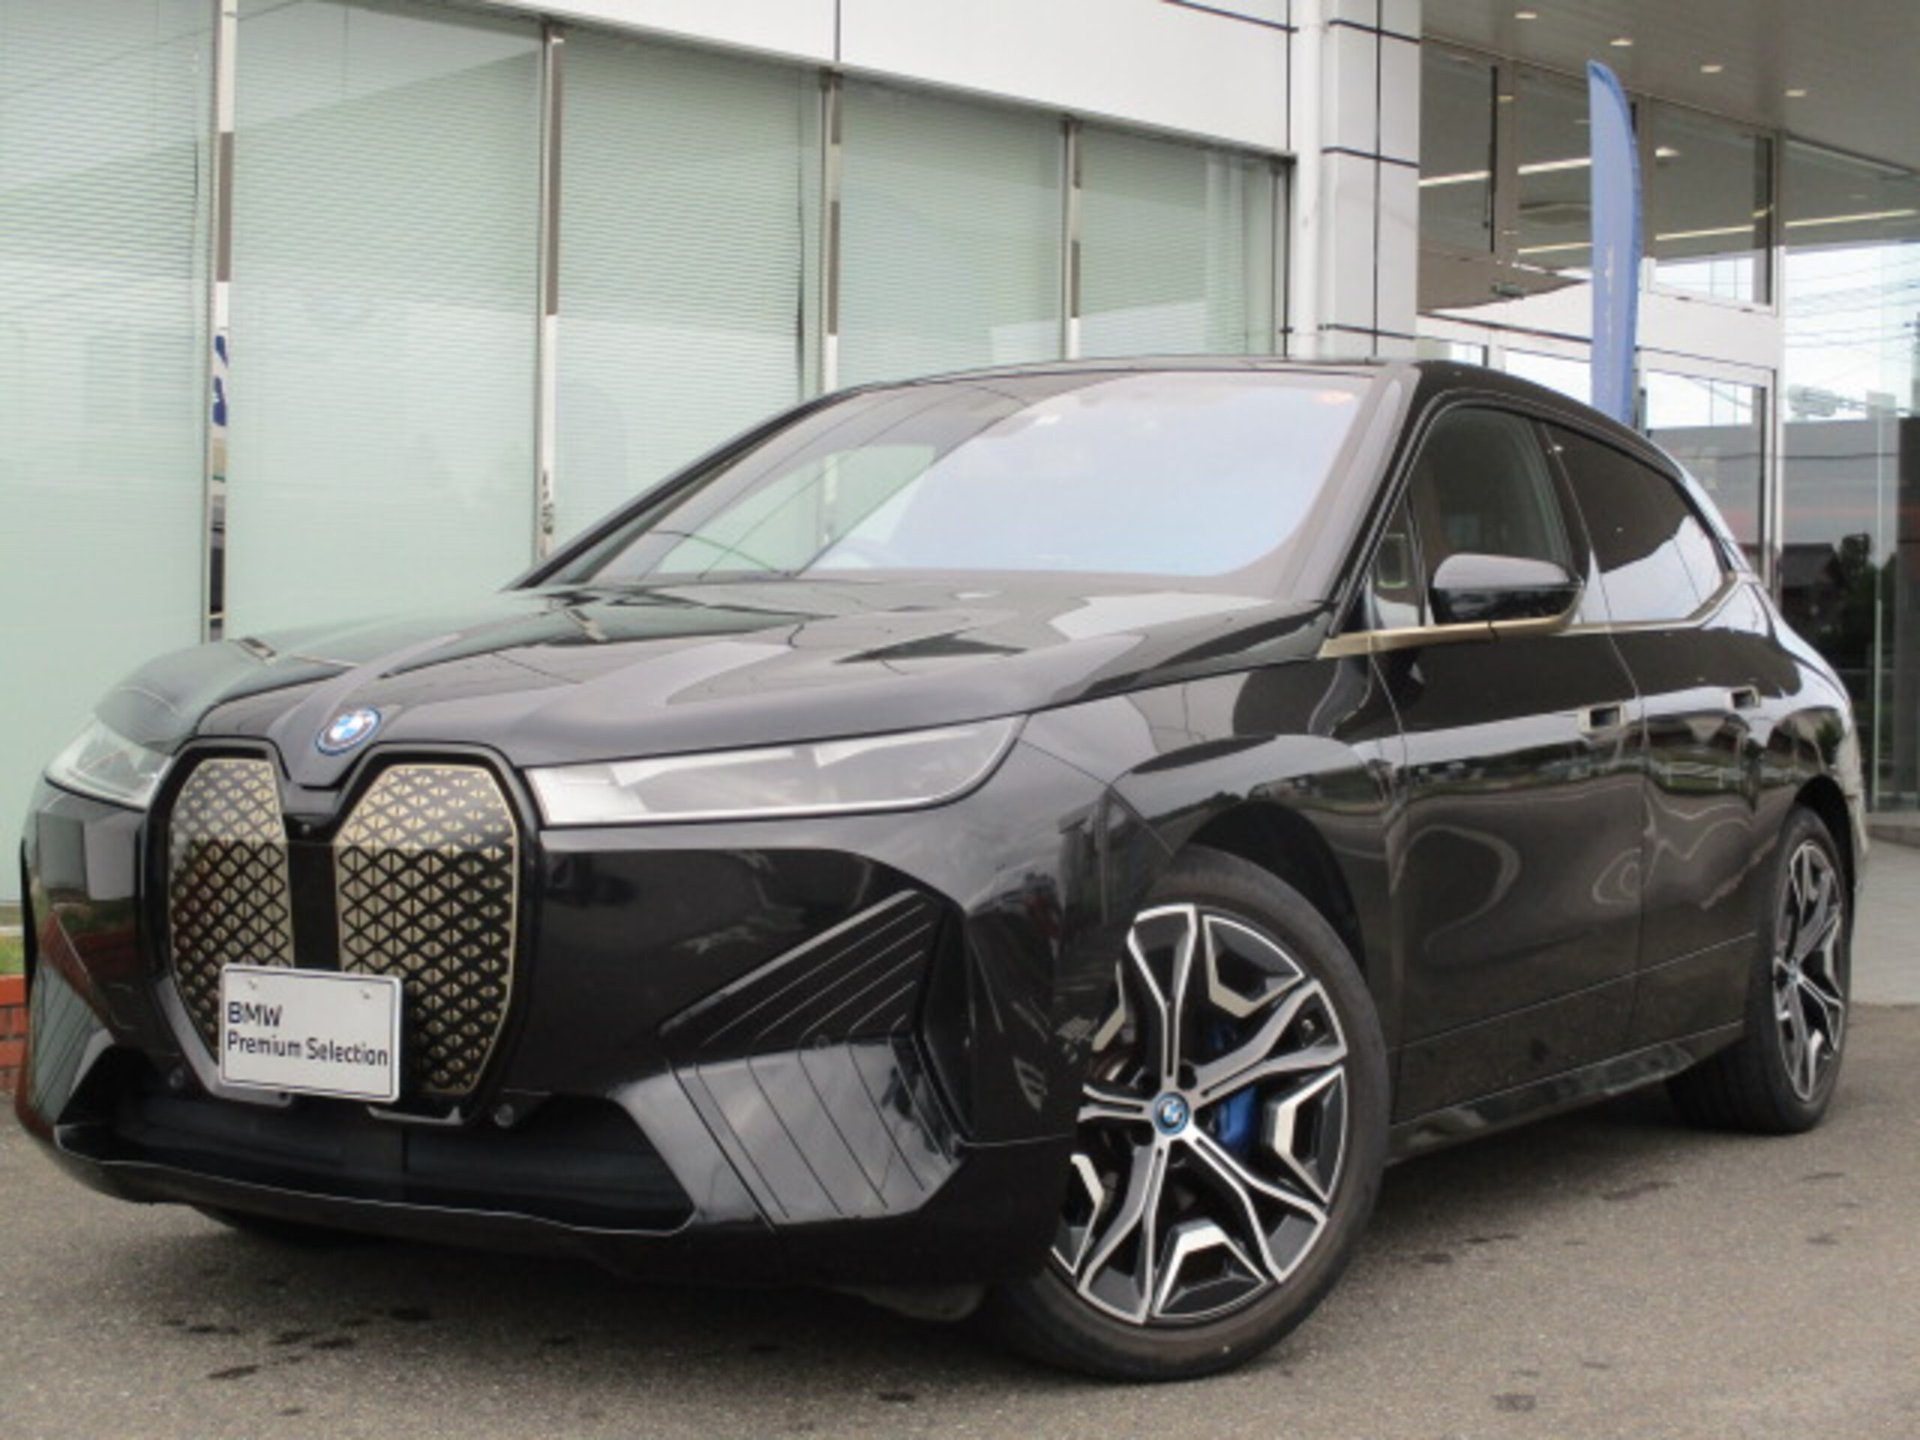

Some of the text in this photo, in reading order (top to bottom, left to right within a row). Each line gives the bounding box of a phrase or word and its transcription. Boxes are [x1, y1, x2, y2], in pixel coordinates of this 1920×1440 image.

[227, 1001, 282, 1026] BMW
[227, 1031, 388, 1066] Premium Selection
